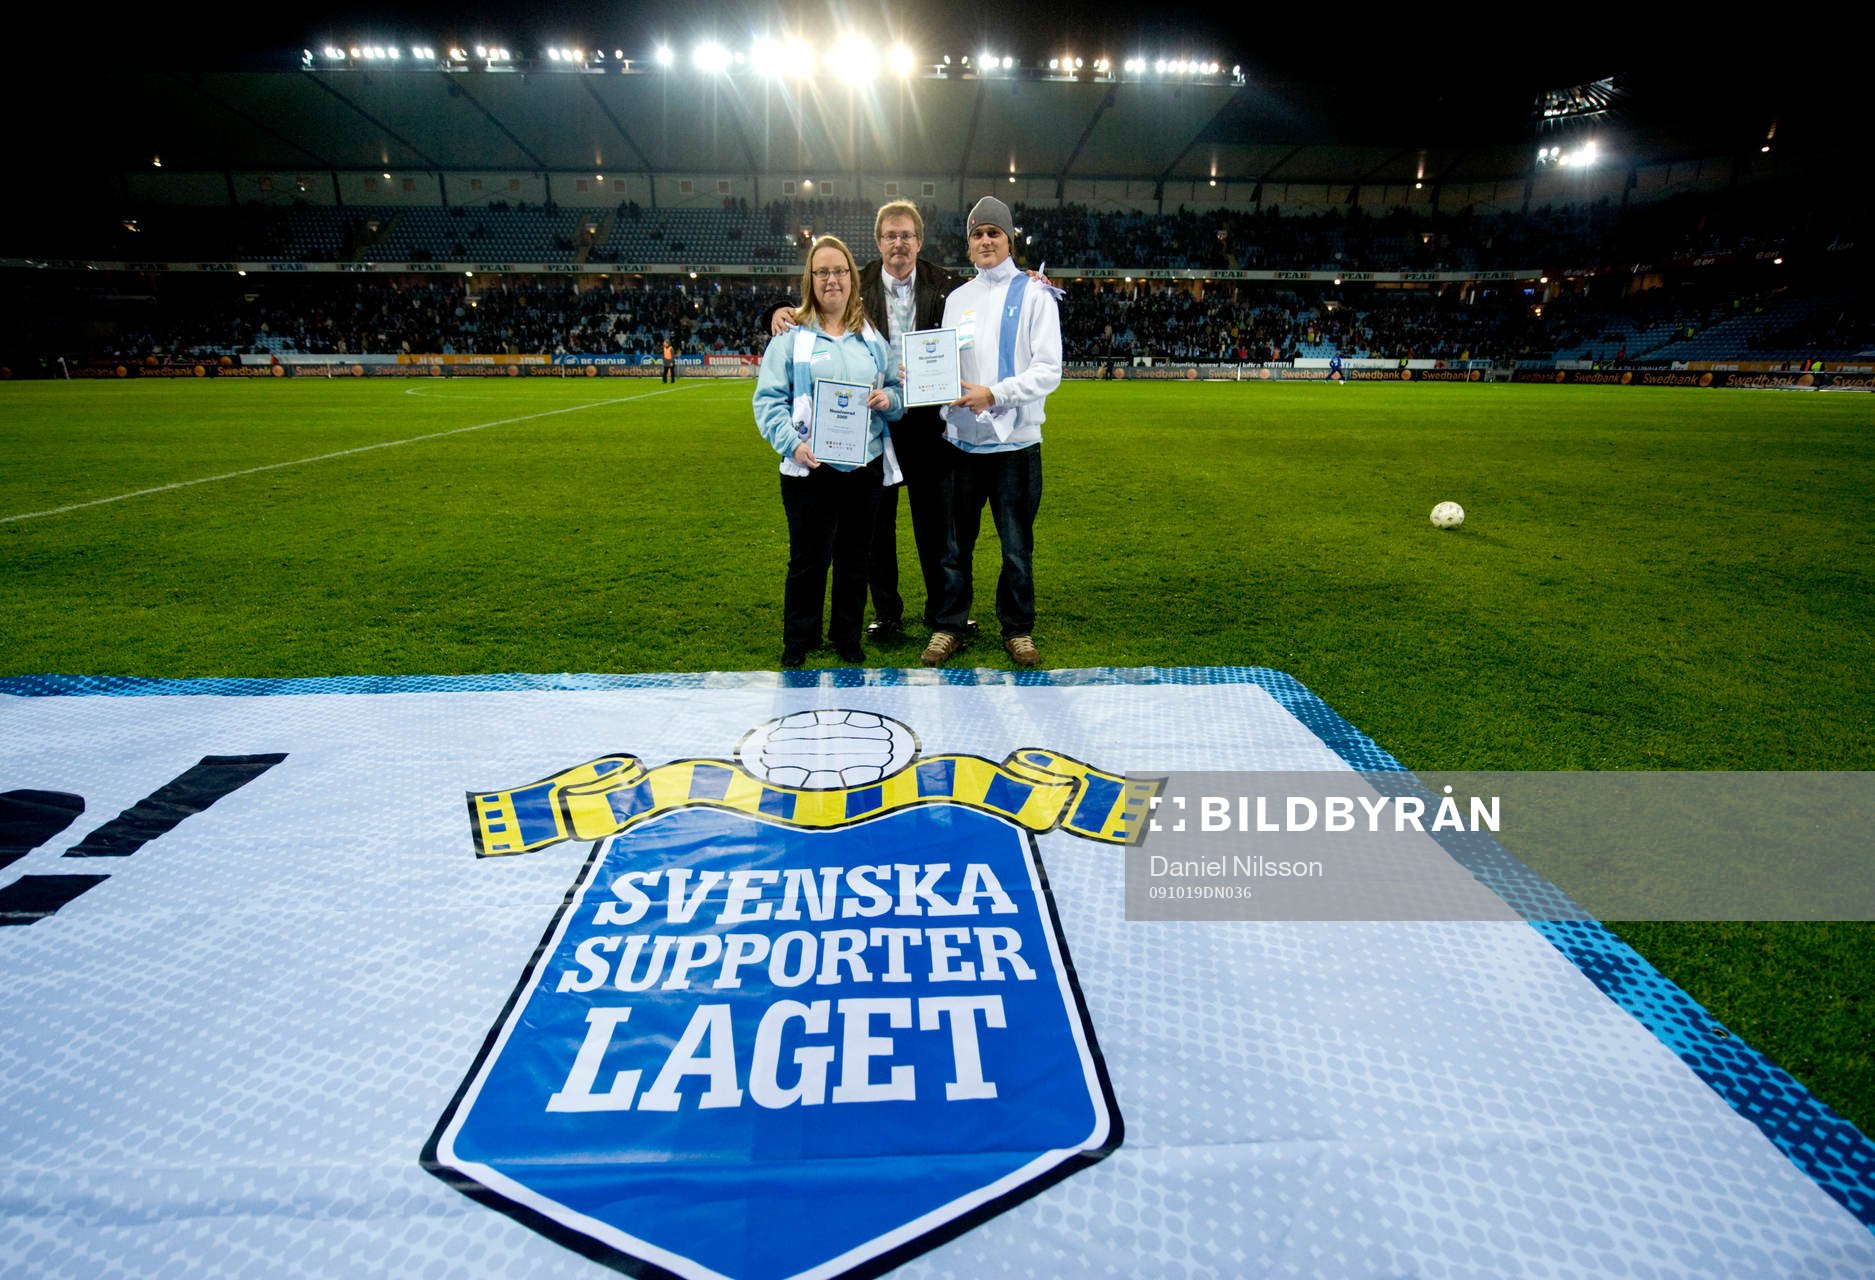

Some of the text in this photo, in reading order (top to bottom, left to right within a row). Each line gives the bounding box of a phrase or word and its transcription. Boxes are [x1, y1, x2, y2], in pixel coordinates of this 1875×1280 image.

[140, 366, 194, 377] Swedbank
[217, 366, 273, 377] Swedbank
[295, 366, 351, 377] Swedbank
[375, 366, 431, 377] Swedbank
[453, 366, 506, 377] Swedbank
[531, 366, 584, 377] Swedbank
[608, 366, 661, 377] Swedbank
[1136, 369, 1185, 379] Swedbank
[1352, 369, 1400, 380] Swedbank
[1421, 369, 1469, 381] Swedbank
[1574, 372, 1621, 383] Swedbank
[1643, 372, 1698, 385] Swedbank
[1726, 373, 1797, 388] Swedbank
[591, 862, 1020, 926] SVENSKA
[555, 926, 1037, 994] SUPPORTER
[545, 994, 1007, 1113] LAGET
